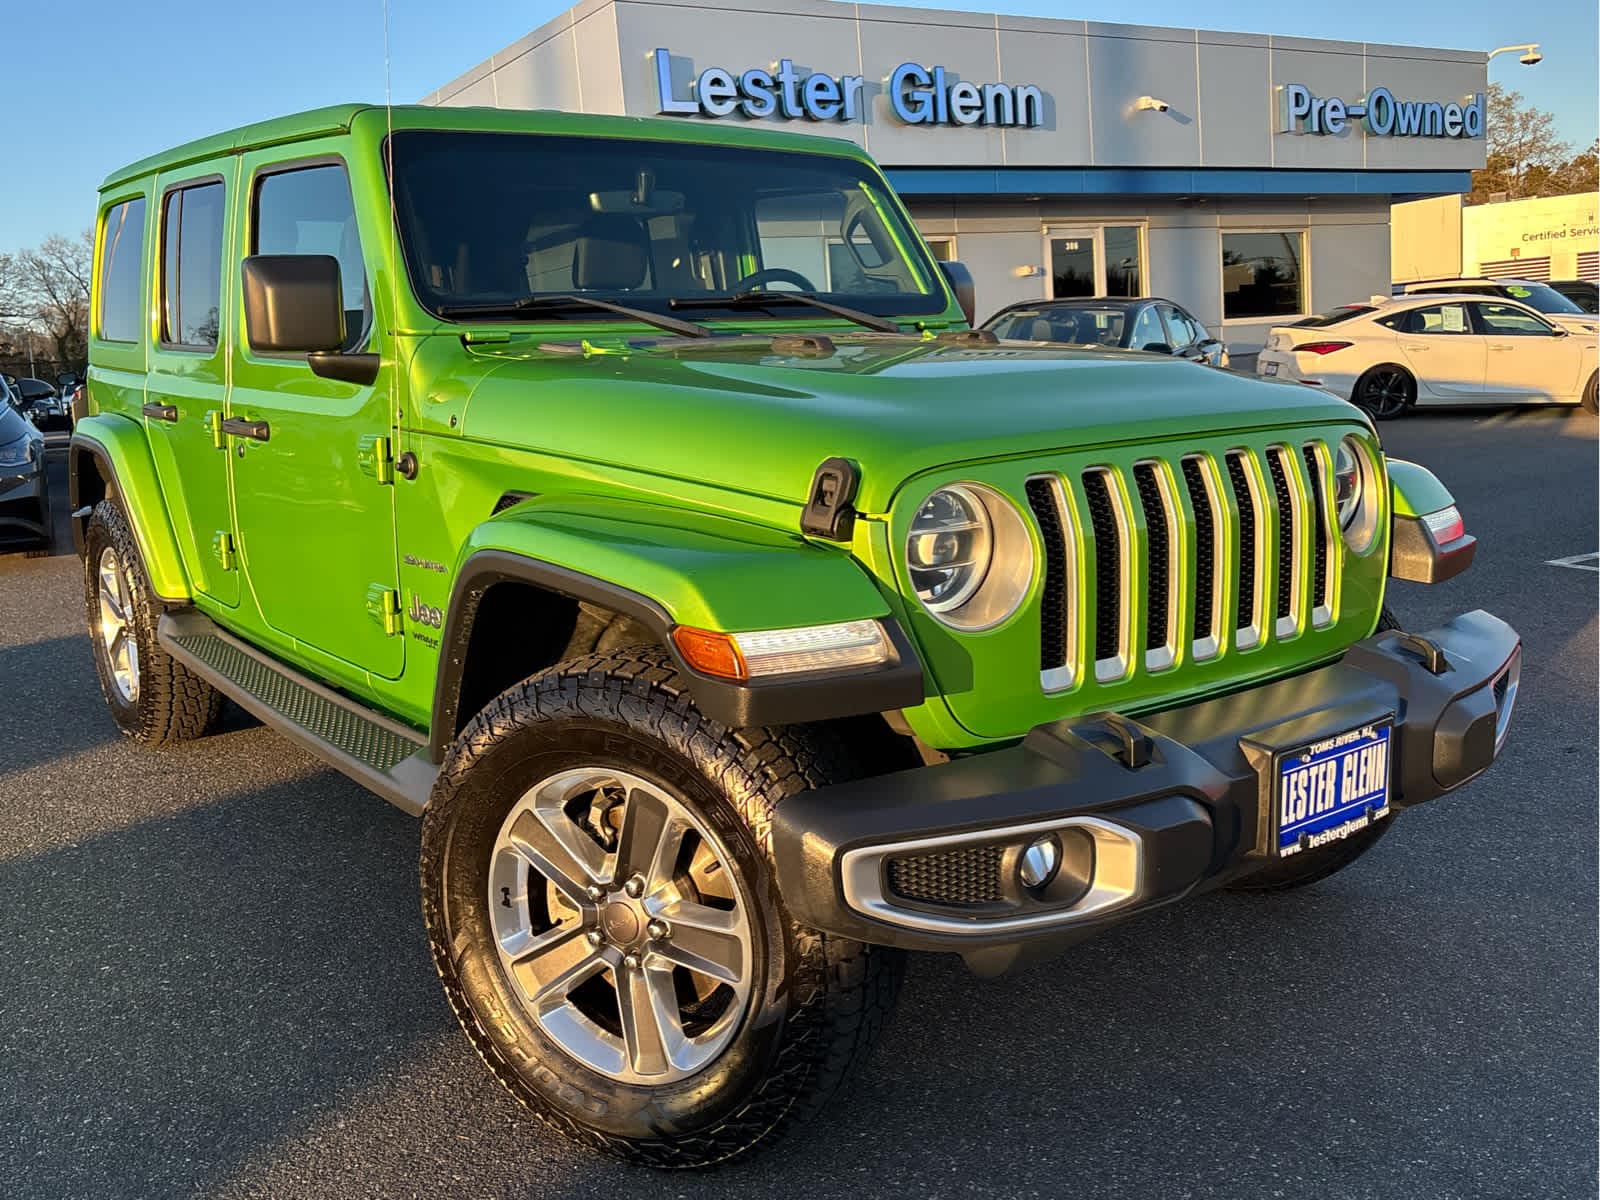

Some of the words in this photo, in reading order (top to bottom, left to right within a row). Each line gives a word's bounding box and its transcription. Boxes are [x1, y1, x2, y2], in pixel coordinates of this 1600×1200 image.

[655, 48, 863, 120] Lester
[889, 63, 1043, 126] Glenn
[1287, 84, 1483, 136] Pre-Owned
[1521, 229, 1566, 242] Certified
[1280, 760, 1337, 826] LESTER
[1342, 742, 1385, 803] GLENN
